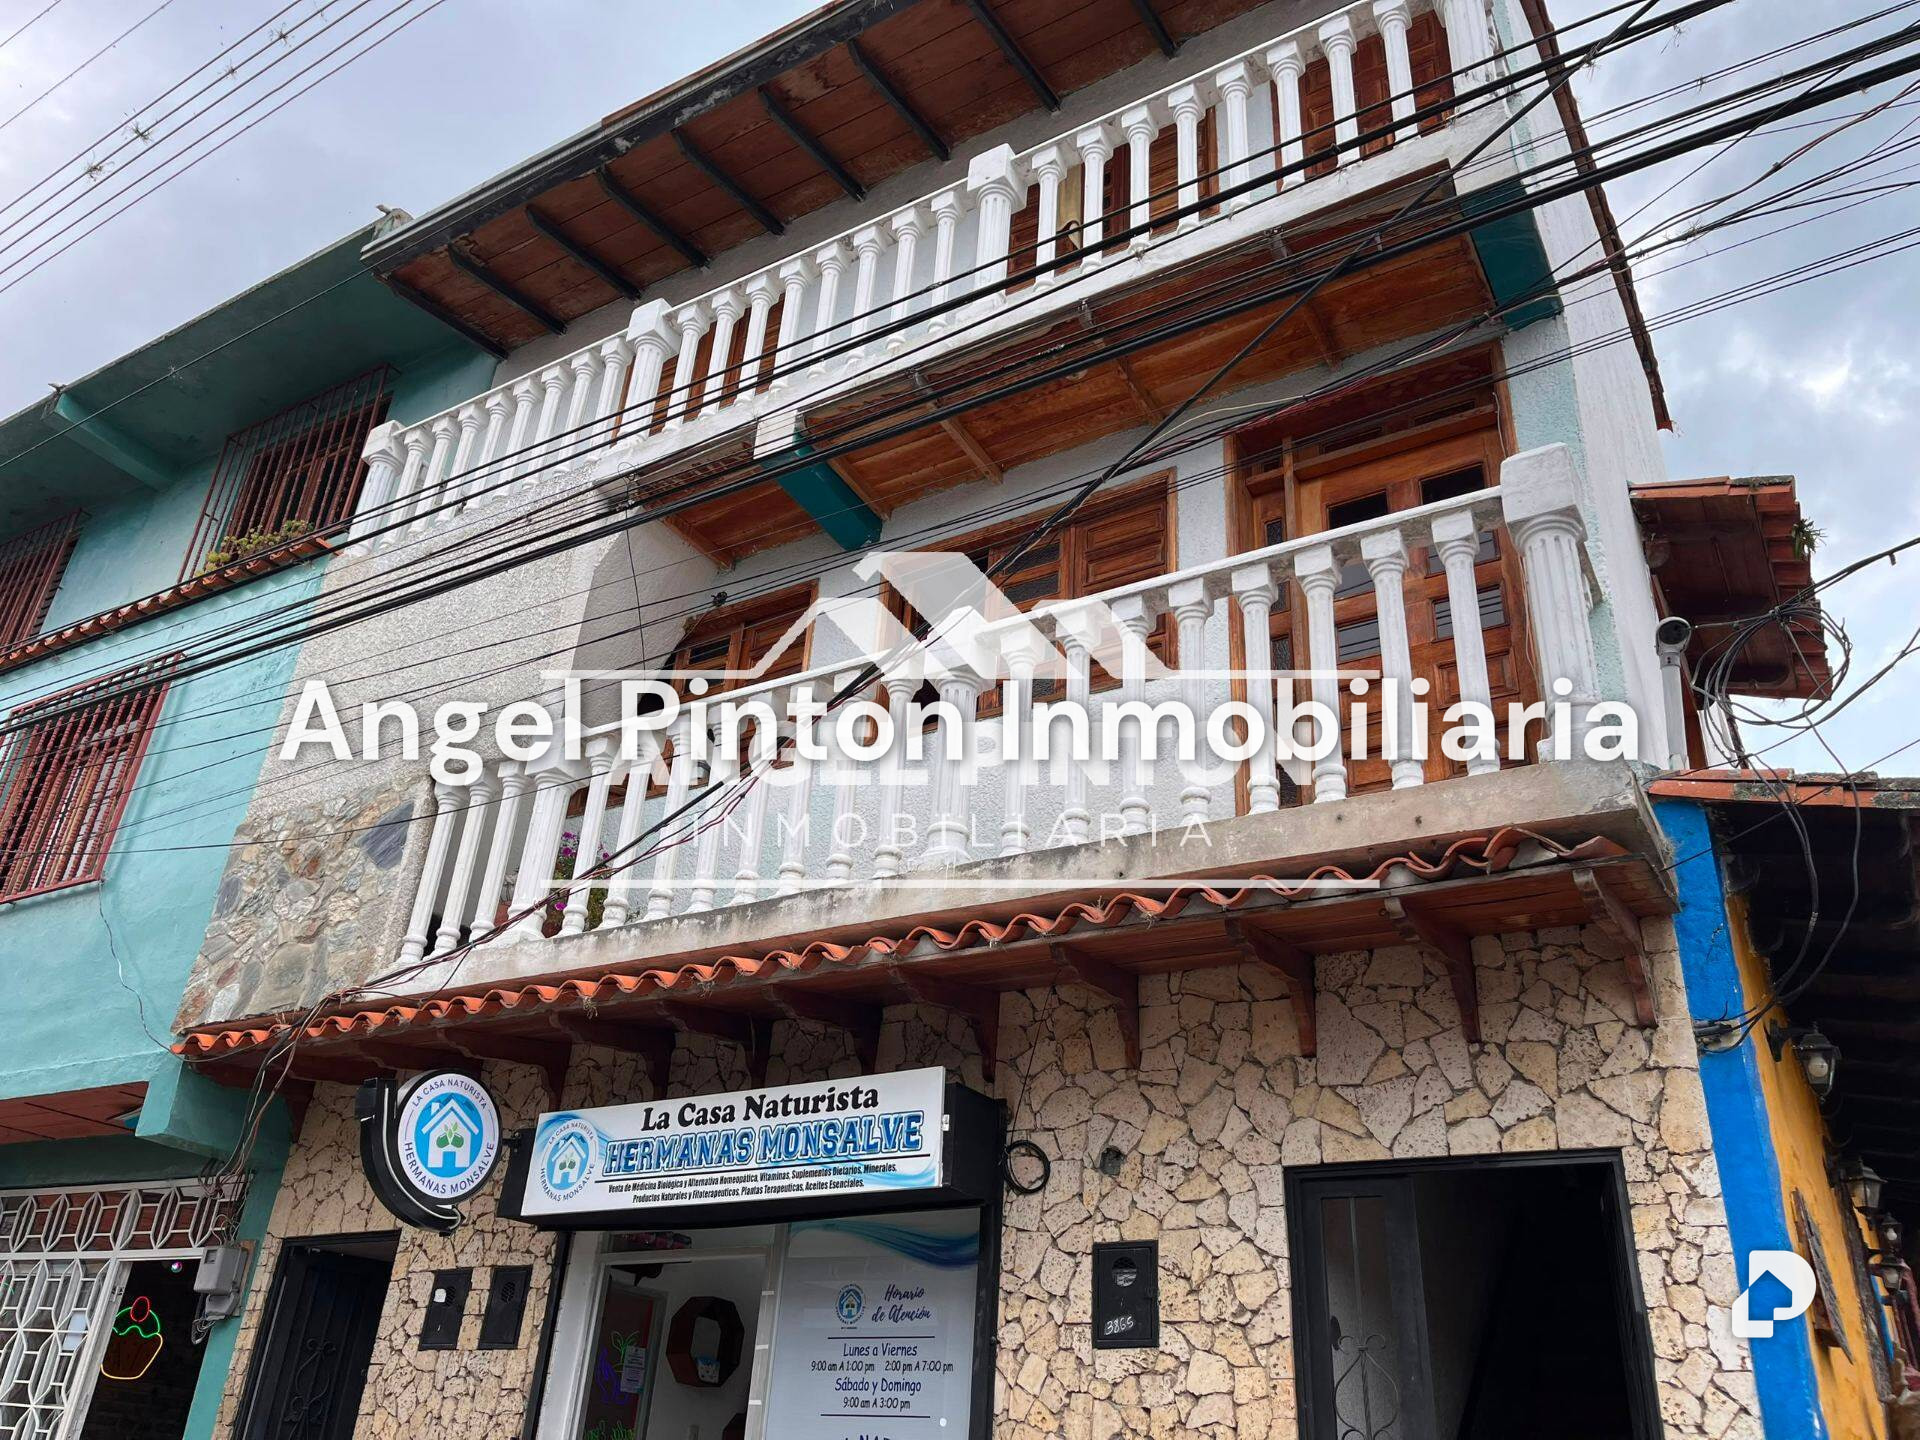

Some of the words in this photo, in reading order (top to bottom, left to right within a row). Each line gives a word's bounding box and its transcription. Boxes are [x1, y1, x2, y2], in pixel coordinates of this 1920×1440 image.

[413, 1095, 424, 1108] LA
[422, 1079, 446, 1096] CASA
[447, 1078, 487, 1109] NATURISTA
[641, 1107, 671, 1131] La
[677, 1102, 736, 1128] Casa
[742, 1085, 879, 1121] Naturista
[555, 1123, 570, 1138] CASA
[571, 1120, 595, 1141] NATURISTA
[602, 1123, 756, 1178] HERMANAS
[757, 1110, 924, 1165] MONSALVE
[404, 1141, 447, 1194] HERMANAS
[449, 1142, 495, 1195] MONSALVE
[541, 1167, 562, 1203] HERMANAS
[562, 1163, 596, 1201] MONSALVE
[608, 1184, 624, 1193] Venta
[624, 1183, 631, 1192] de
[688, 1176, 719, 1187] Alternativa
[792, 1167, 832, 1180] Suplementos
[632, 1192, 660, 1203] Productos
[661, 1190, 688, 1201] Naturales
[741, 1184, 763, 1195] Plantas
[805, 1180, 828, 1190] Aceites
[884, 1283, 925, 1302] Horario
[872, 1306, 885, 1322] de
[888, 1304, 931, 1323] Atención
[1104, 1316, 1134, 1335] 3865
[843, 1343, 870, 1357] Lunes
[872, 1346, 878, 1356] a
[881, 1342, 918, 1356] Viernes
[811, 1360, 827, 1372] 9:00
[827, 1363, 837, 1371] am
[839, 1361, 845, 1371] A
[846, 1360, 863, 1372] 1:00
[864, 1363, 875, 1374] pm
[885, 1360, 901, 1372] 2:00
[902, 1363, 913, 1374] pm
[914, 1361, 920, 1371] A
[922, 1360, 942, 1372] 7:00
[943, 1363, 954, 1374] pm
[835, 1376, 869, 1391] Sábado
[872, 1381, 878, 1395] y
[880, 1378, 922, 1396] Domingo
[843, 1397, 859, 1408] 9:00
[860, 1400, 870, 1408] am
[872, 1398, 877, 1408] A
[880, 1398, 898, 1409] 3:00
[900, 1400, 911, 1411] pm
